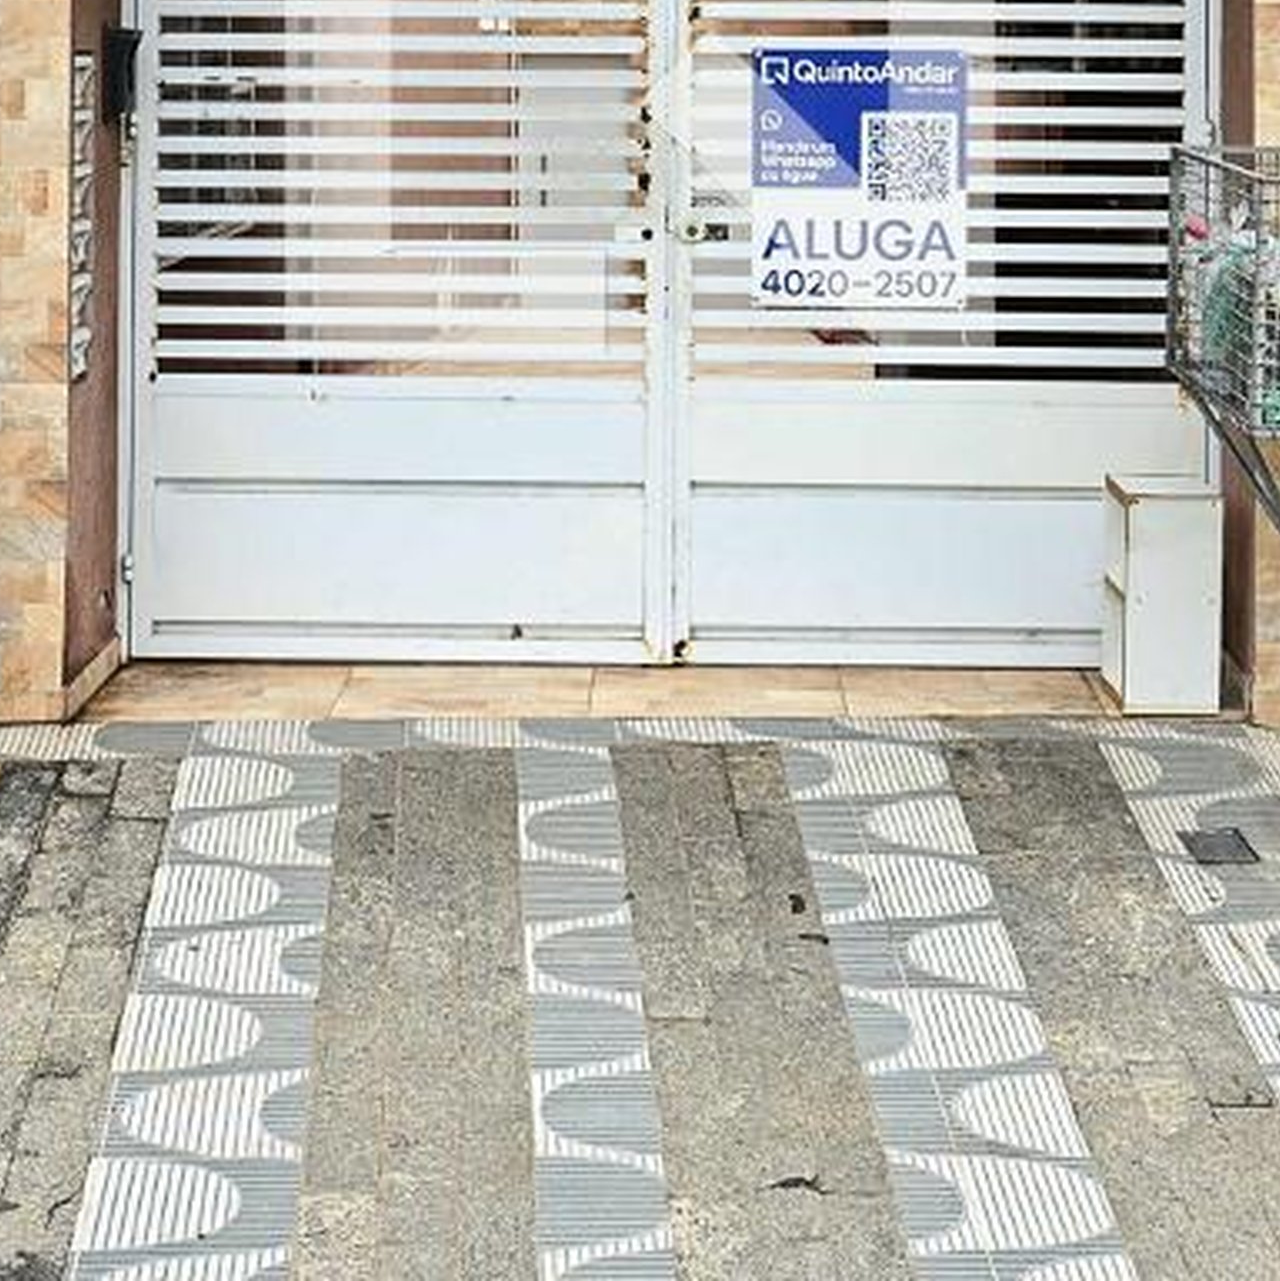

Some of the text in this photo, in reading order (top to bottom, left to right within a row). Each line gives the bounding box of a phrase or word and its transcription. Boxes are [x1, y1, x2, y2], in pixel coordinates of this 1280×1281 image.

[793, 60, 958, 84] QuintoAndar
[762, 219, 956, 261] ALUGA
[761, 270, 957, 297] 4020-2507
